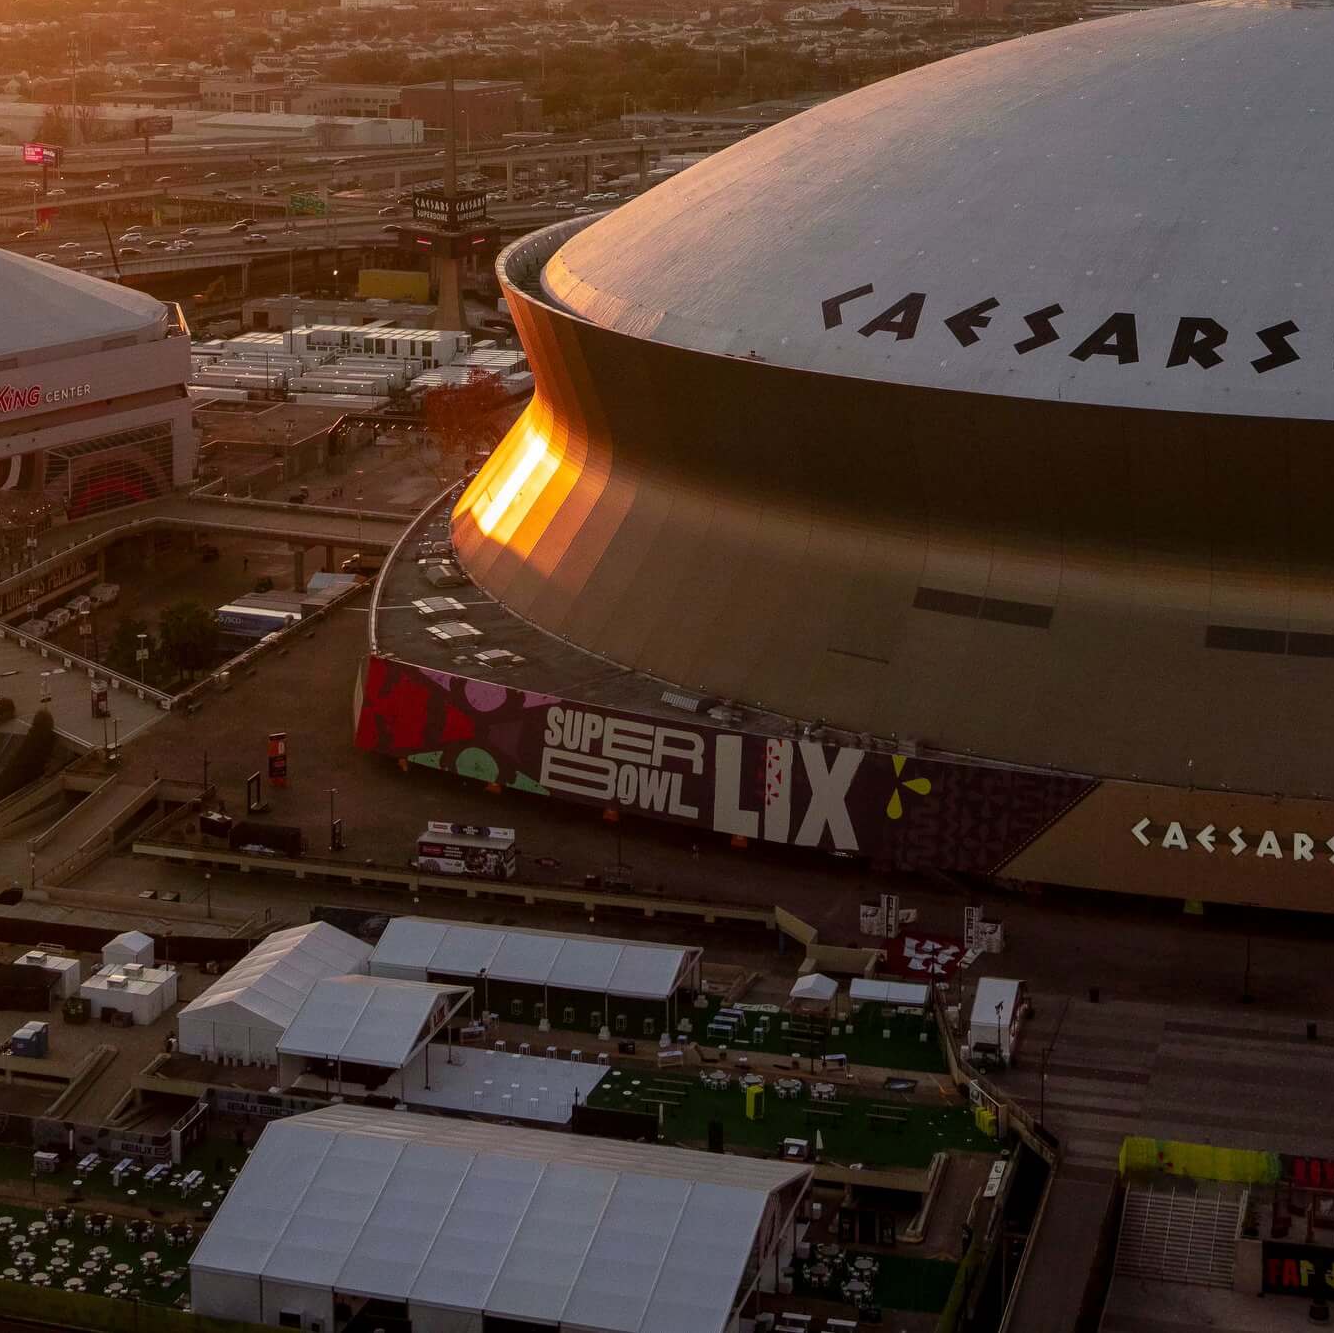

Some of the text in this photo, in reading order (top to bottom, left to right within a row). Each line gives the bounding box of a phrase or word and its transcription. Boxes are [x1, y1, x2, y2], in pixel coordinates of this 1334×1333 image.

[415, 198, 450, 211] CAESARS
[456, 196, 485, 211] CAESARS
[821, 282, 1301, 373] CAESARS
[46, 384, 91, 403] CENTER
[544, 706, 704, 775] SUPER
[540, 747, 699, 820] BOWL
[713, 734, 865, 852] LIX
